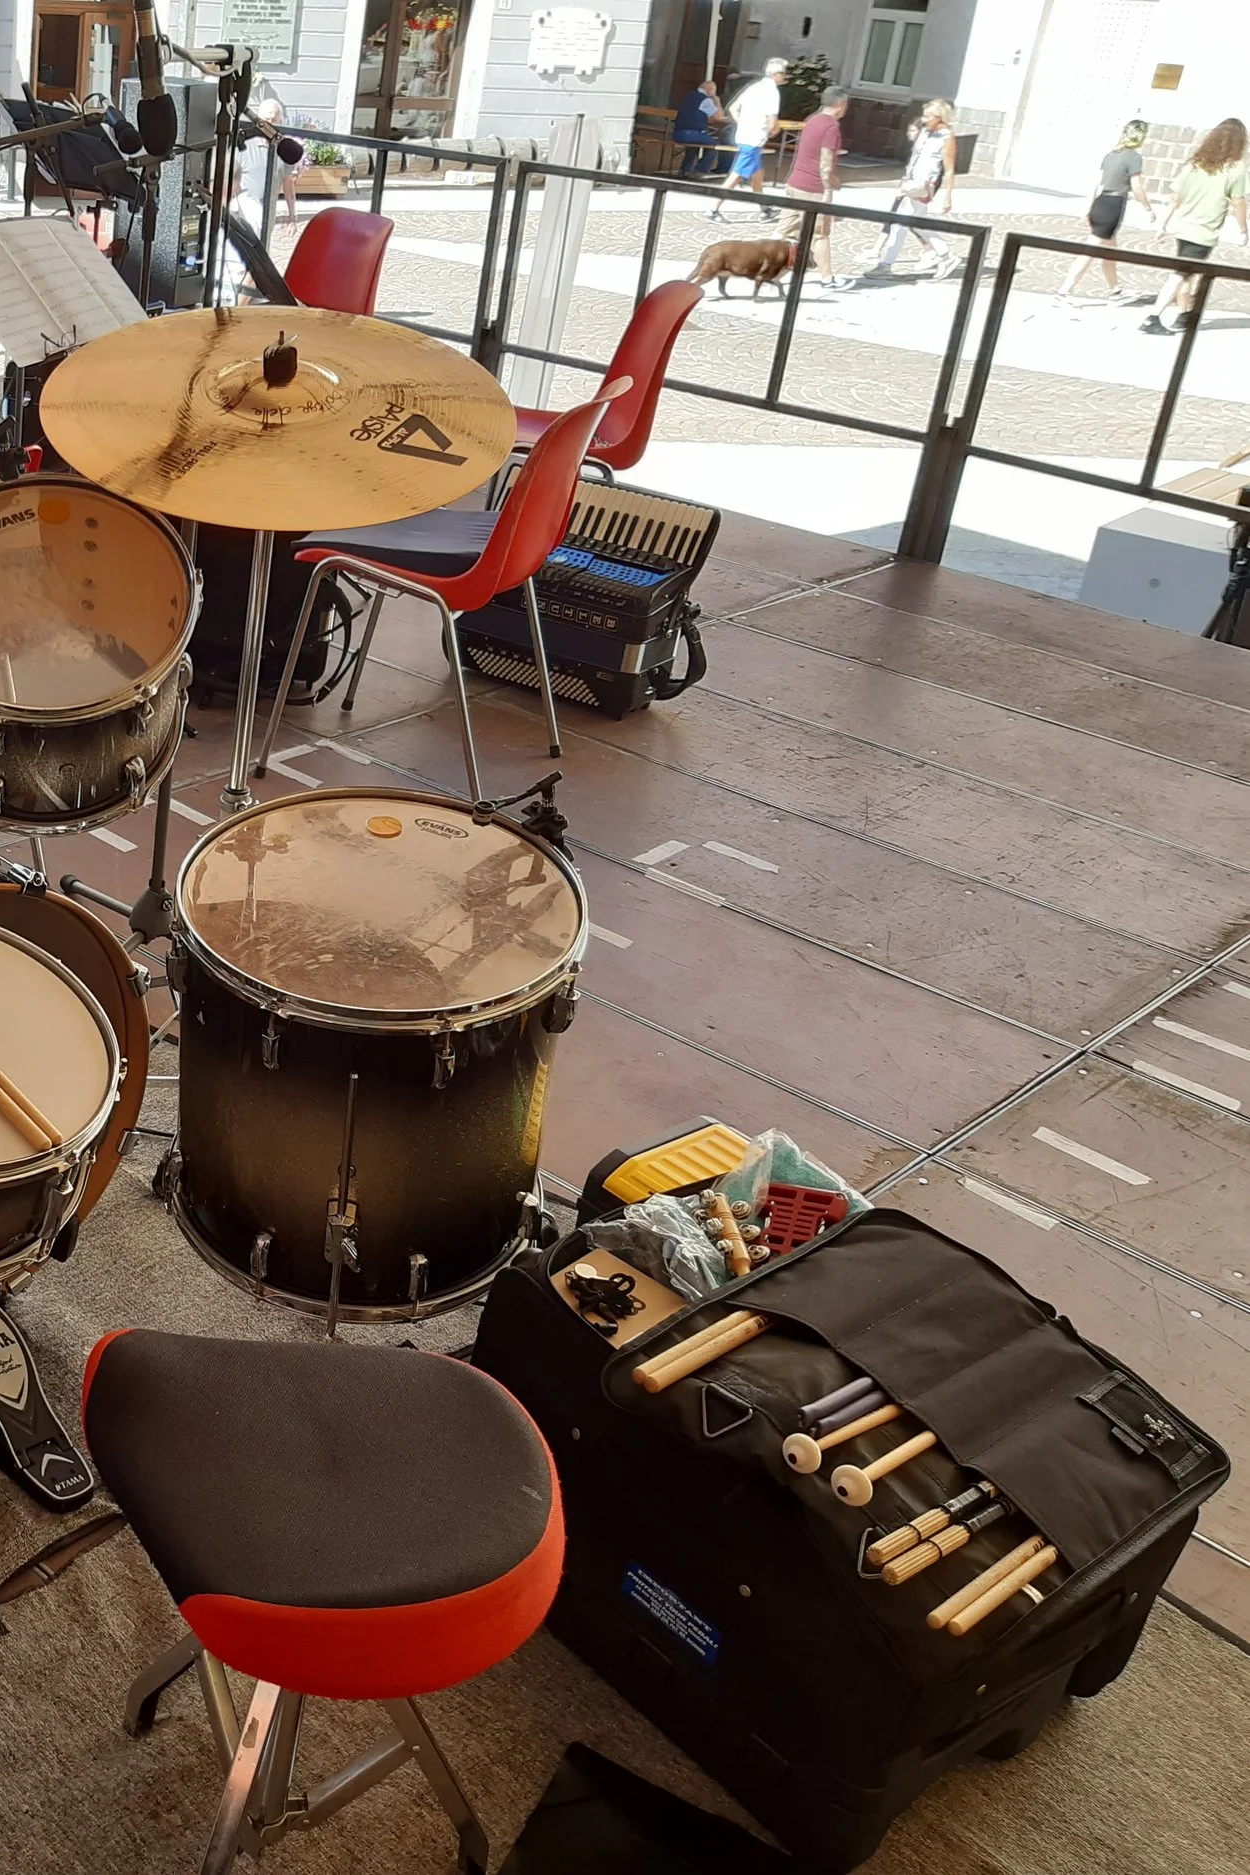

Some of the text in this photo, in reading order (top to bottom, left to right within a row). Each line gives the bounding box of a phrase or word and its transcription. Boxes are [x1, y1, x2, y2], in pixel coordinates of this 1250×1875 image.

[177, 440, 218, 478] FULL RIDE
[523, 597, 617, 629] BELTUN
[421, 820, 462, 837] EVANS
[60, 1474, 85, 1490] TAMA
[627, 1571, 664, 1601] PROTECT
[664, 1601, 687, 1622] YOUR
